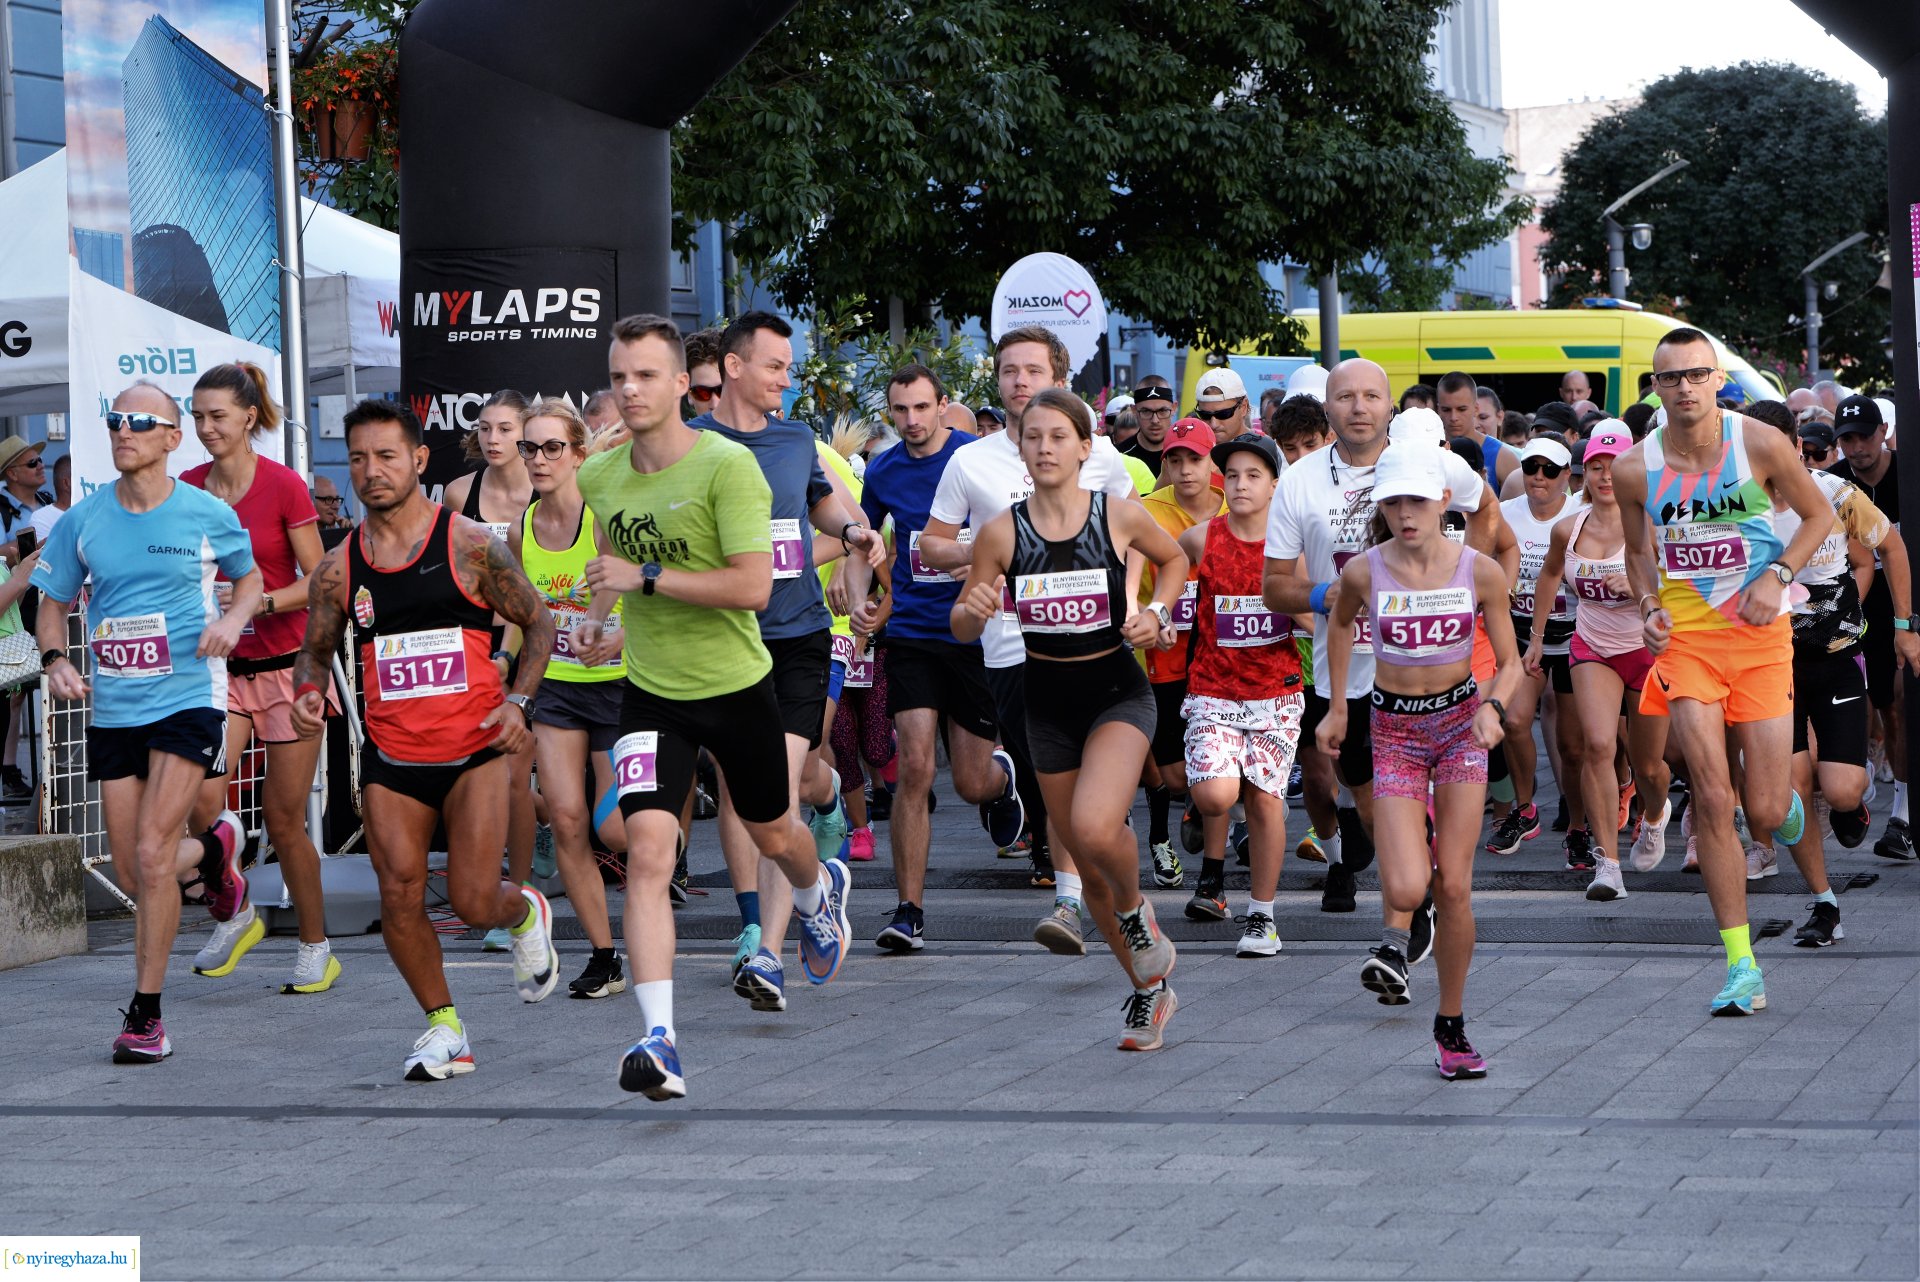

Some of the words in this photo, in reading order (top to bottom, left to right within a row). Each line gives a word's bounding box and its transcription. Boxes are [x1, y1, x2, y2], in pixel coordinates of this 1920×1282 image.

[413, 288, 600, 326] MYLAPS
[448, 329, 522, 342] SPORTS
[531, 327, 597, 340] TIMING
[1661, 491, 1747, 526] BERLIN
[148, 545, 196, 557] GARMIN
[630, 541, 689, 556] DRAGON
[1676, 544, 1735, 567] 5072
[1030, 599, 1097, 622] 5089
[1233, 616, 1273, 636] 504
[1391, 619, 1461, 644] 5142
[101, 642, 159, 666] 5078
[389, 657, 454, 686] 5117
[1394, 694, 1449, 712] NIKE
[1250, 735, 1284, 769] CHICAGO
